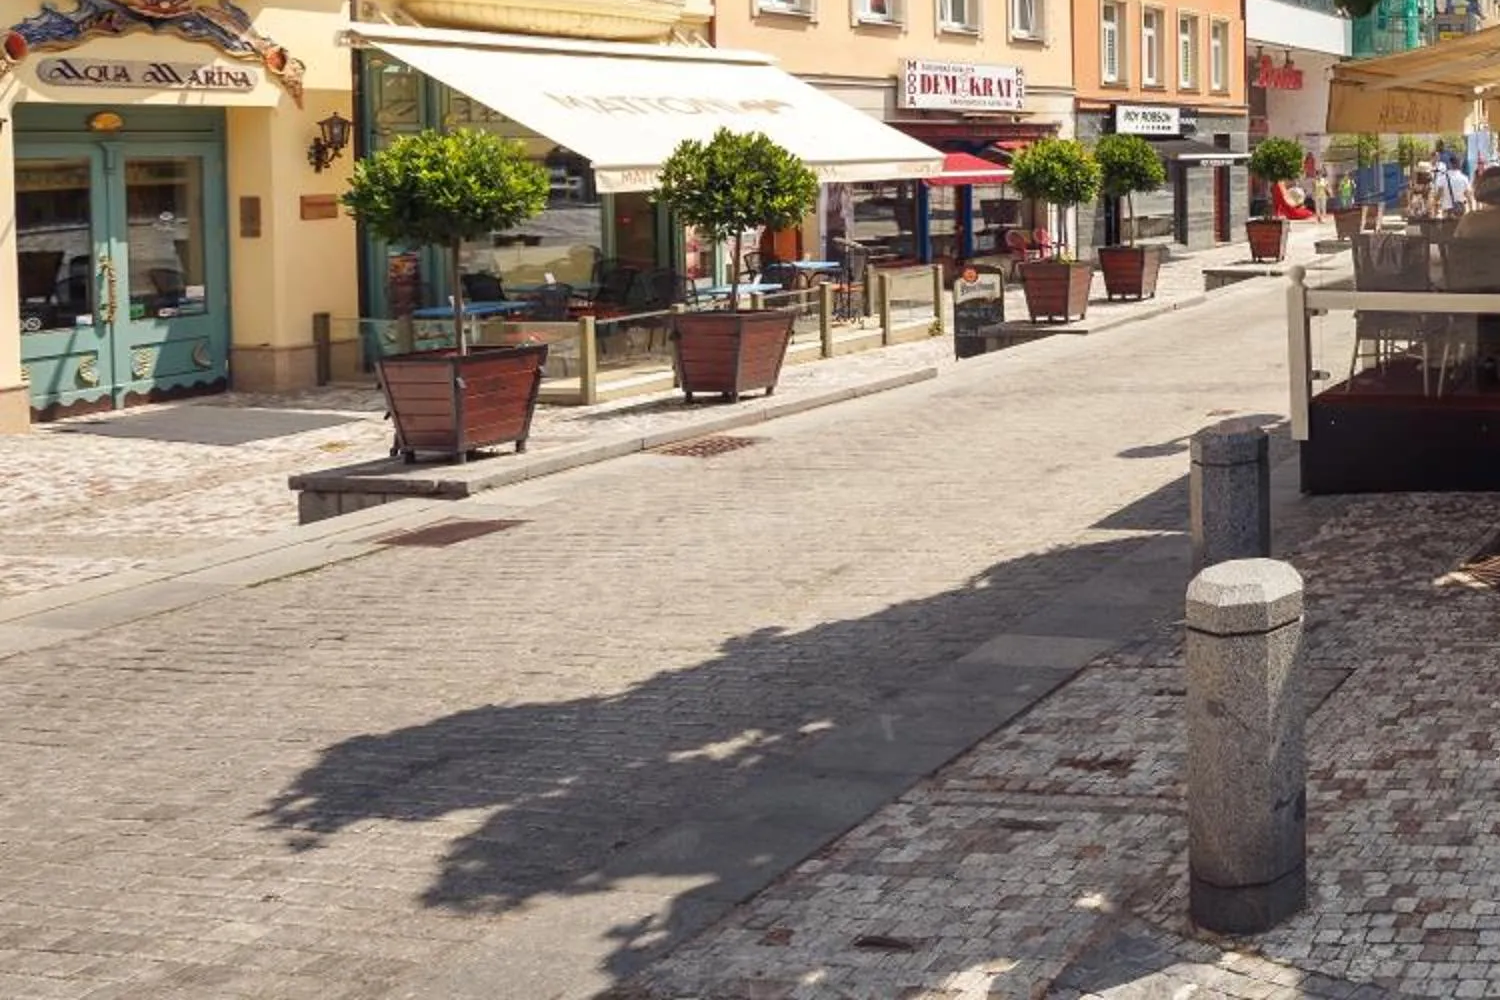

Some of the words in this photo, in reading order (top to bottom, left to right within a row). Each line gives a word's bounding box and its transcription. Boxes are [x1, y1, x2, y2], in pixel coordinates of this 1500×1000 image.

[51, 58, 132, 83] AQUA
[143, 63, 253, 87] MARINA
[907, 60, 917, 106] MODA
